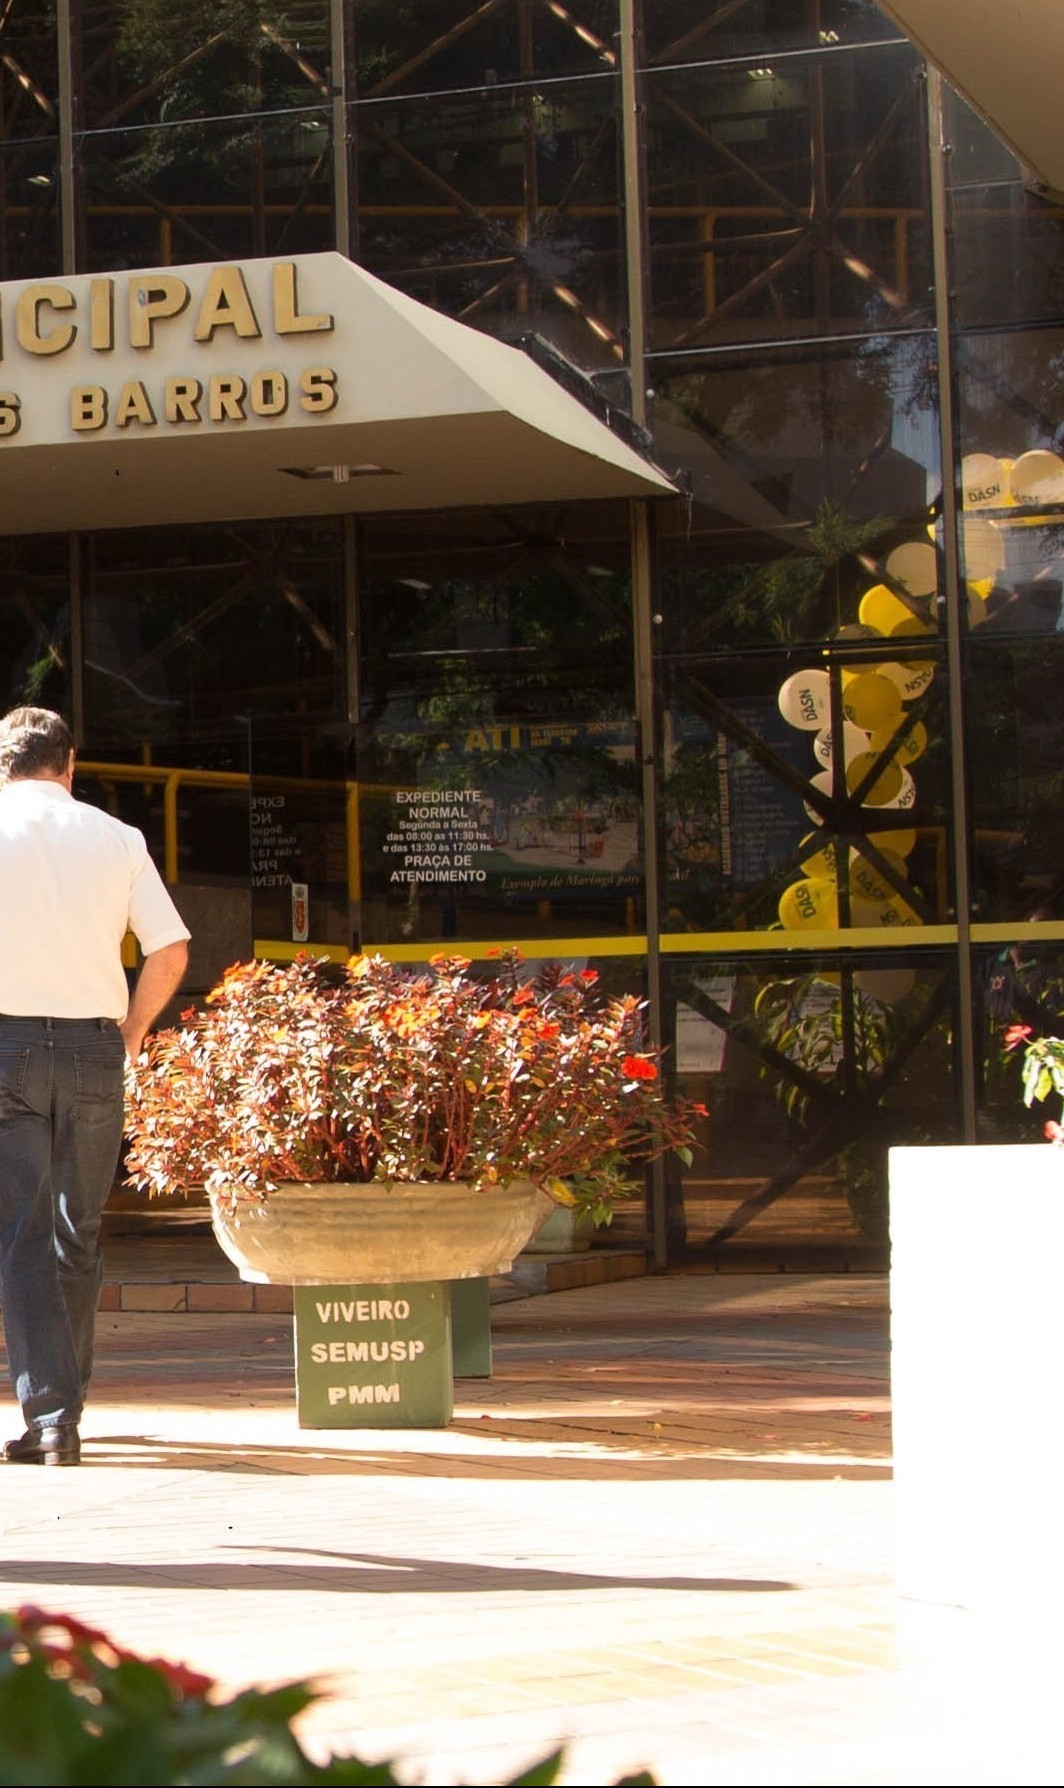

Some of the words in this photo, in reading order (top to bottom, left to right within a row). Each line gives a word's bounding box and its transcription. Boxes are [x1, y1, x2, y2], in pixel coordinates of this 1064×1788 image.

[70, 366, 340, 432] BARROS
[968, 484, 1001, 503] DASN
[798, 688, 818, 722] DASN
[464, 723, 520, 752] ATI
[396, 790, 482, 803] EXPEDIENTE
[408, 806, 469, 819] NORMAL
[451, 820, 478, 829] Sexta
[386, 832, 404, 841] das
[448, 831, 475, 841] 11:30
[382, 844, 389, 853] e
[390, 843, 408, 852] das
[411, 843, 437, 852] 13:30
[452, 842, 479, 852] 17:00
[404, 855, 451, 869] PRAÇA
[454, 854, 473, 867] DE
[390, 869, 487, 883] ATENDIMENTO
[315, 1300, 411, 1324] VIVEIRO
[310, 1340, 425, 1364] SEMUSP
[327, 1382, 401, 1406] PMM
